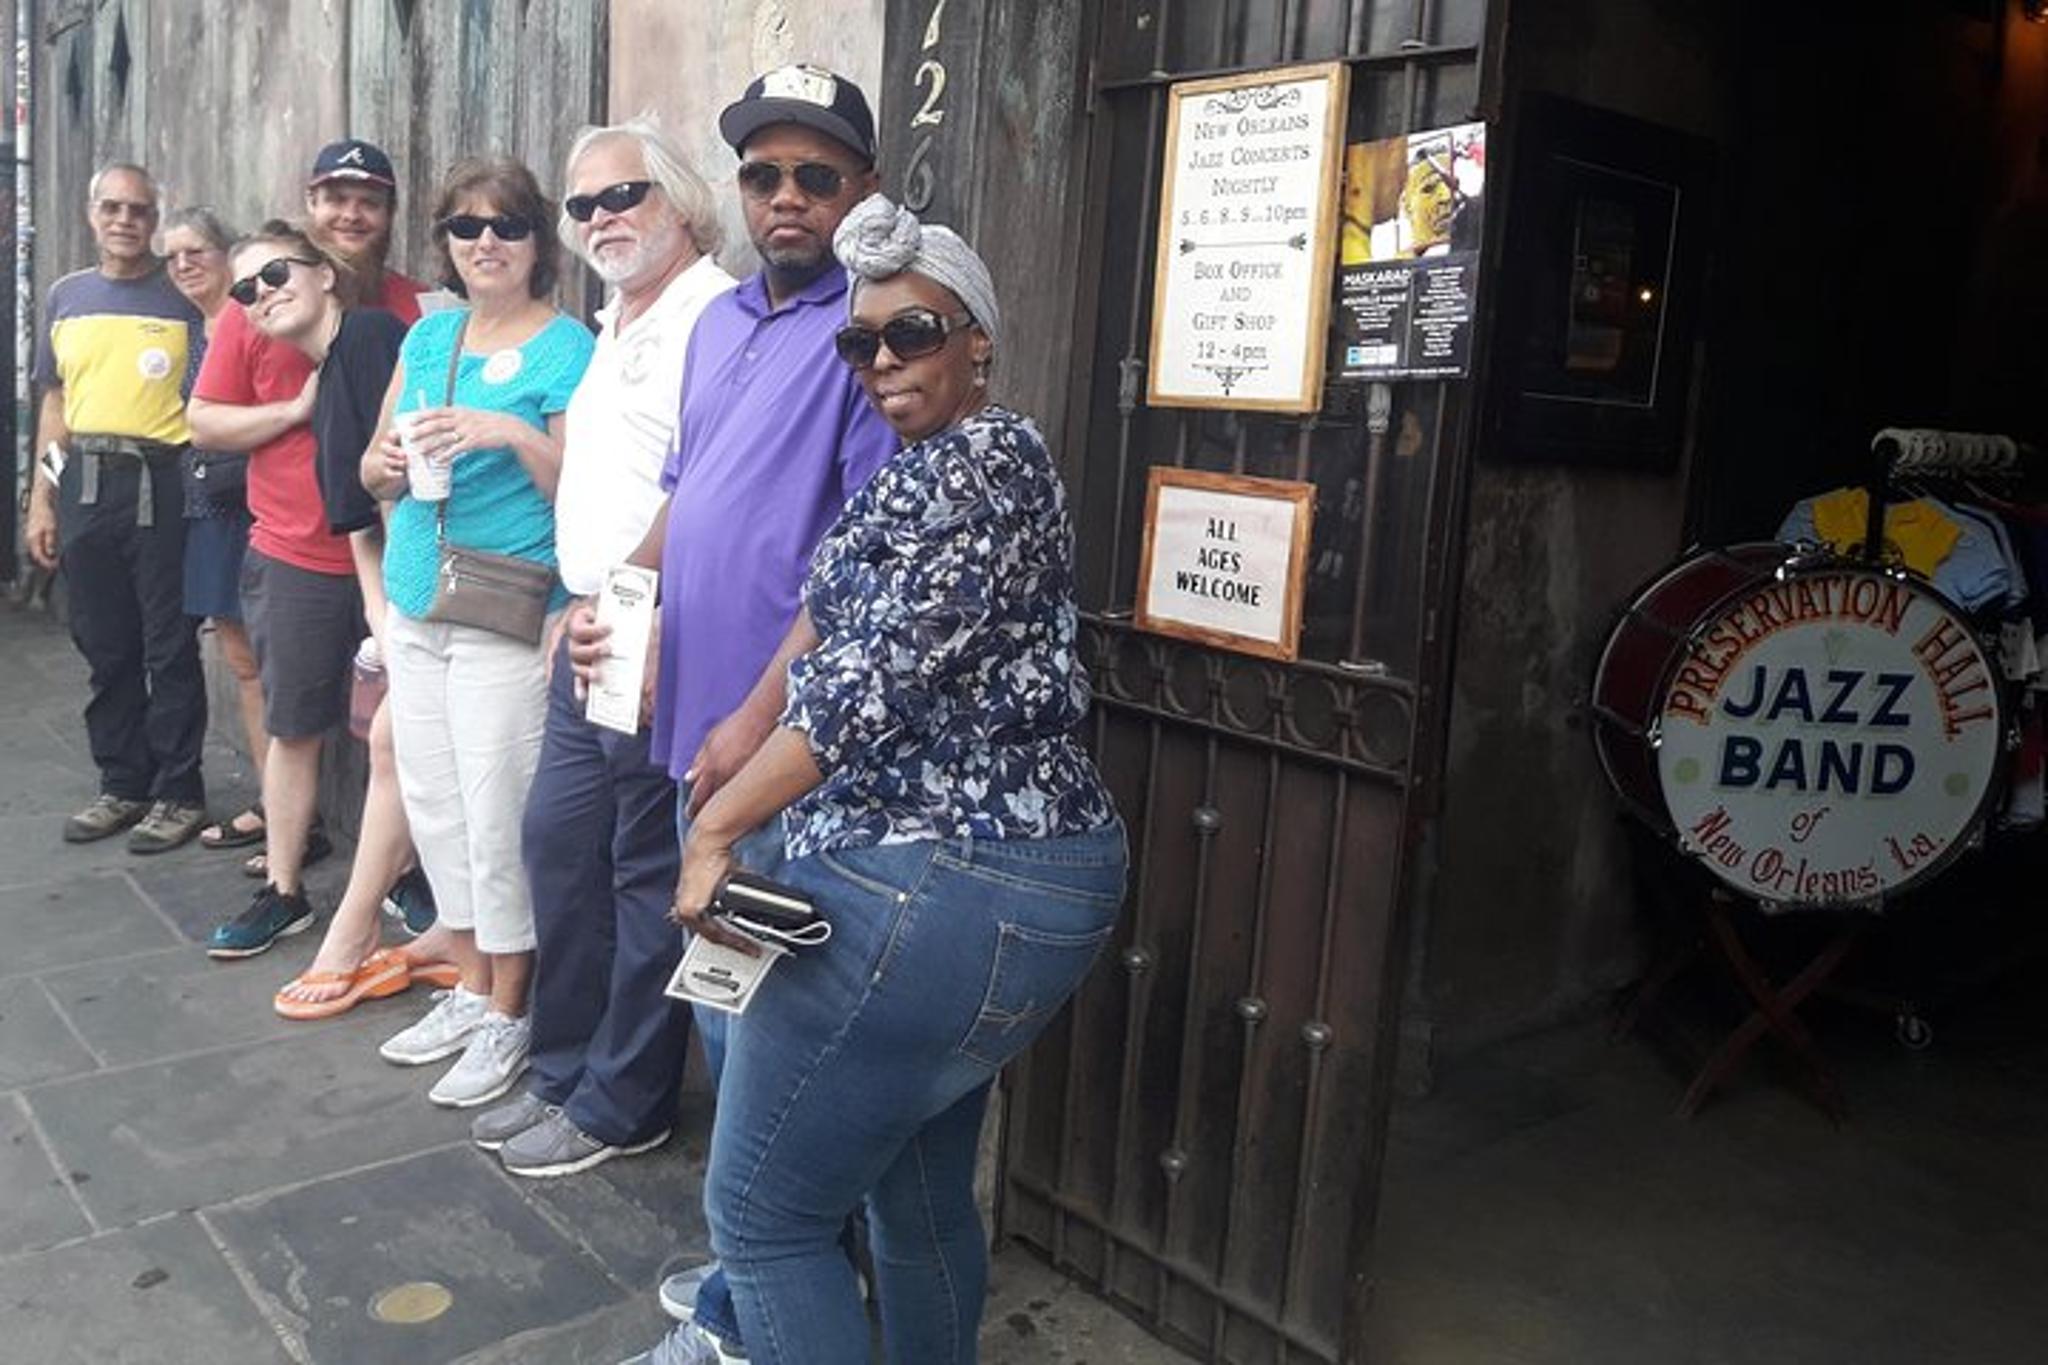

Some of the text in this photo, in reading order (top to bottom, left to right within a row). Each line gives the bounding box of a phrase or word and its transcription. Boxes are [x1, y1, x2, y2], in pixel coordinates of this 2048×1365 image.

[1194, 113, 1310, 140] NEW ORLEANS
[1188, 143, 1311, 170] JAZZ CONCERTS
[1212, 176, 1279, 196] NIGHTLY
[1194, 260, 1283, 279] BOX OFFICE
[1220, 286, 1252, 302] AND
[1192, 311, 1277, 330] GIFT SHOP
[1206, 517, 1237, 540] ALL
[1198, 547, 1241, 573] AGES
[1176, 571, 1262, 607] WELCOME
[1668, 574, 1914, 726] PRESERVATION
[1722, 666, 1915, 727] JAZZ
[1718, 735, 1916, 795] BAND
[1691, 805, 1747, 868] New
[1789, 806, 1831, 842] of
